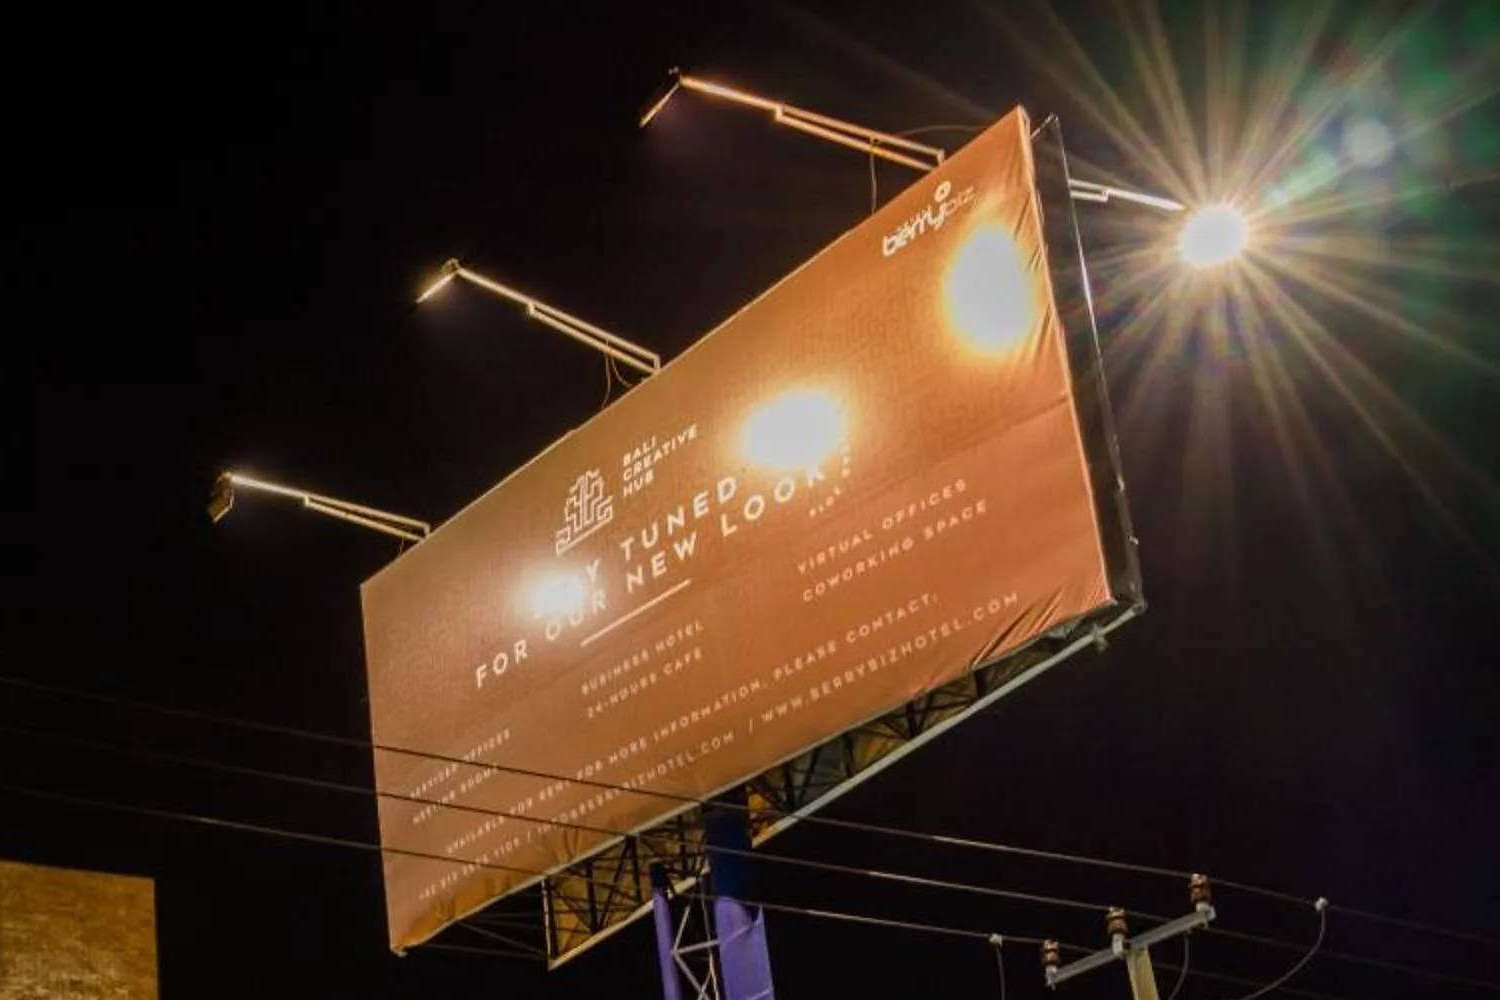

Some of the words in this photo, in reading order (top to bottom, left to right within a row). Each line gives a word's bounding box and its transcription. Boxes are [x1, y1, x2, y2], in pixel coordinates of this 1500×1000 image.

[623, 435, 656, 466] BALI
[623, 423, 698, 481] CREATIVE
[623, 470, 653, 497] HUB
[620, 476, 738, 561] TUNED
[798, 528, 873, 574] VIRTUAL
[882, 478, 965, 531] OFFICES
[803, 536, 914, 602] COWORKING
[923, 499, 986, 541] SPACE
[475, 640, 528, 689] FOR
[545, 589, 606, 640] OUR
[626, 532, 697, 593] NEW
[581, 648, 649, 695] BUSINESS
[655, 619, 704, 652] HOTEL
[608, 737, 647, 765] MORE
[773, 641, 837, 681] PLEASE
